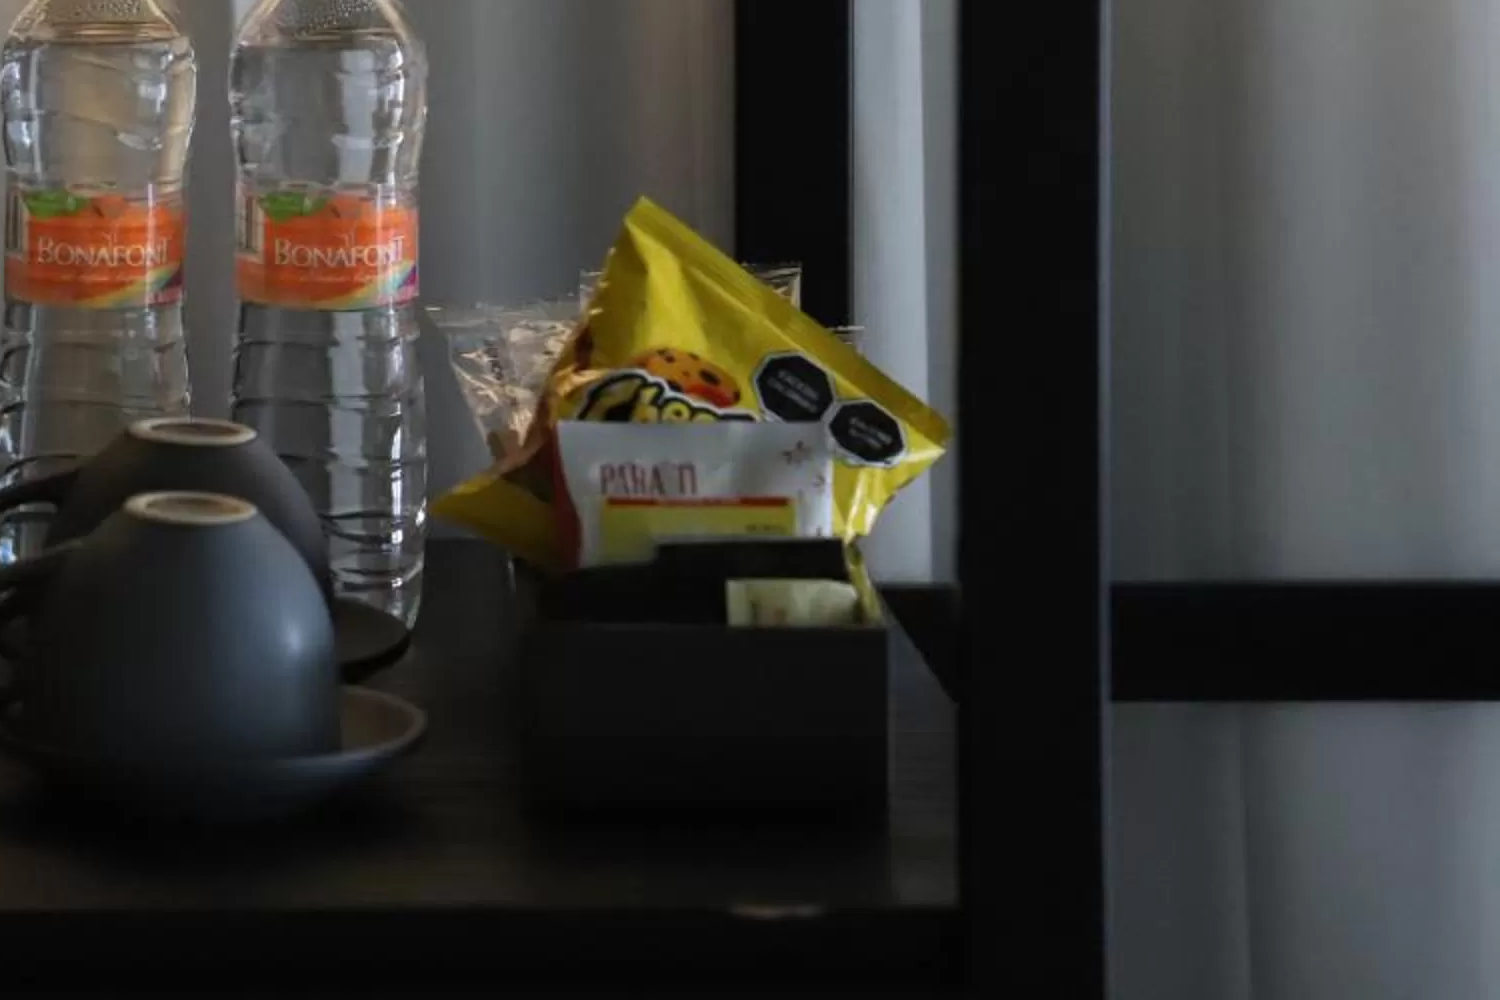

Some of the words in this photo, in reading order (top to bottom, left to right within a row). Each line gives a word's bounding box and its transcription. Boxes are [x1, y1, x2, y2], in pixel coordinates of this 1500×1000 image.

[37, 234, 169, 267] BONAFONT
[274, 235, 404, 268] BONAFONT
[600, 462, 665, 494] PARA
